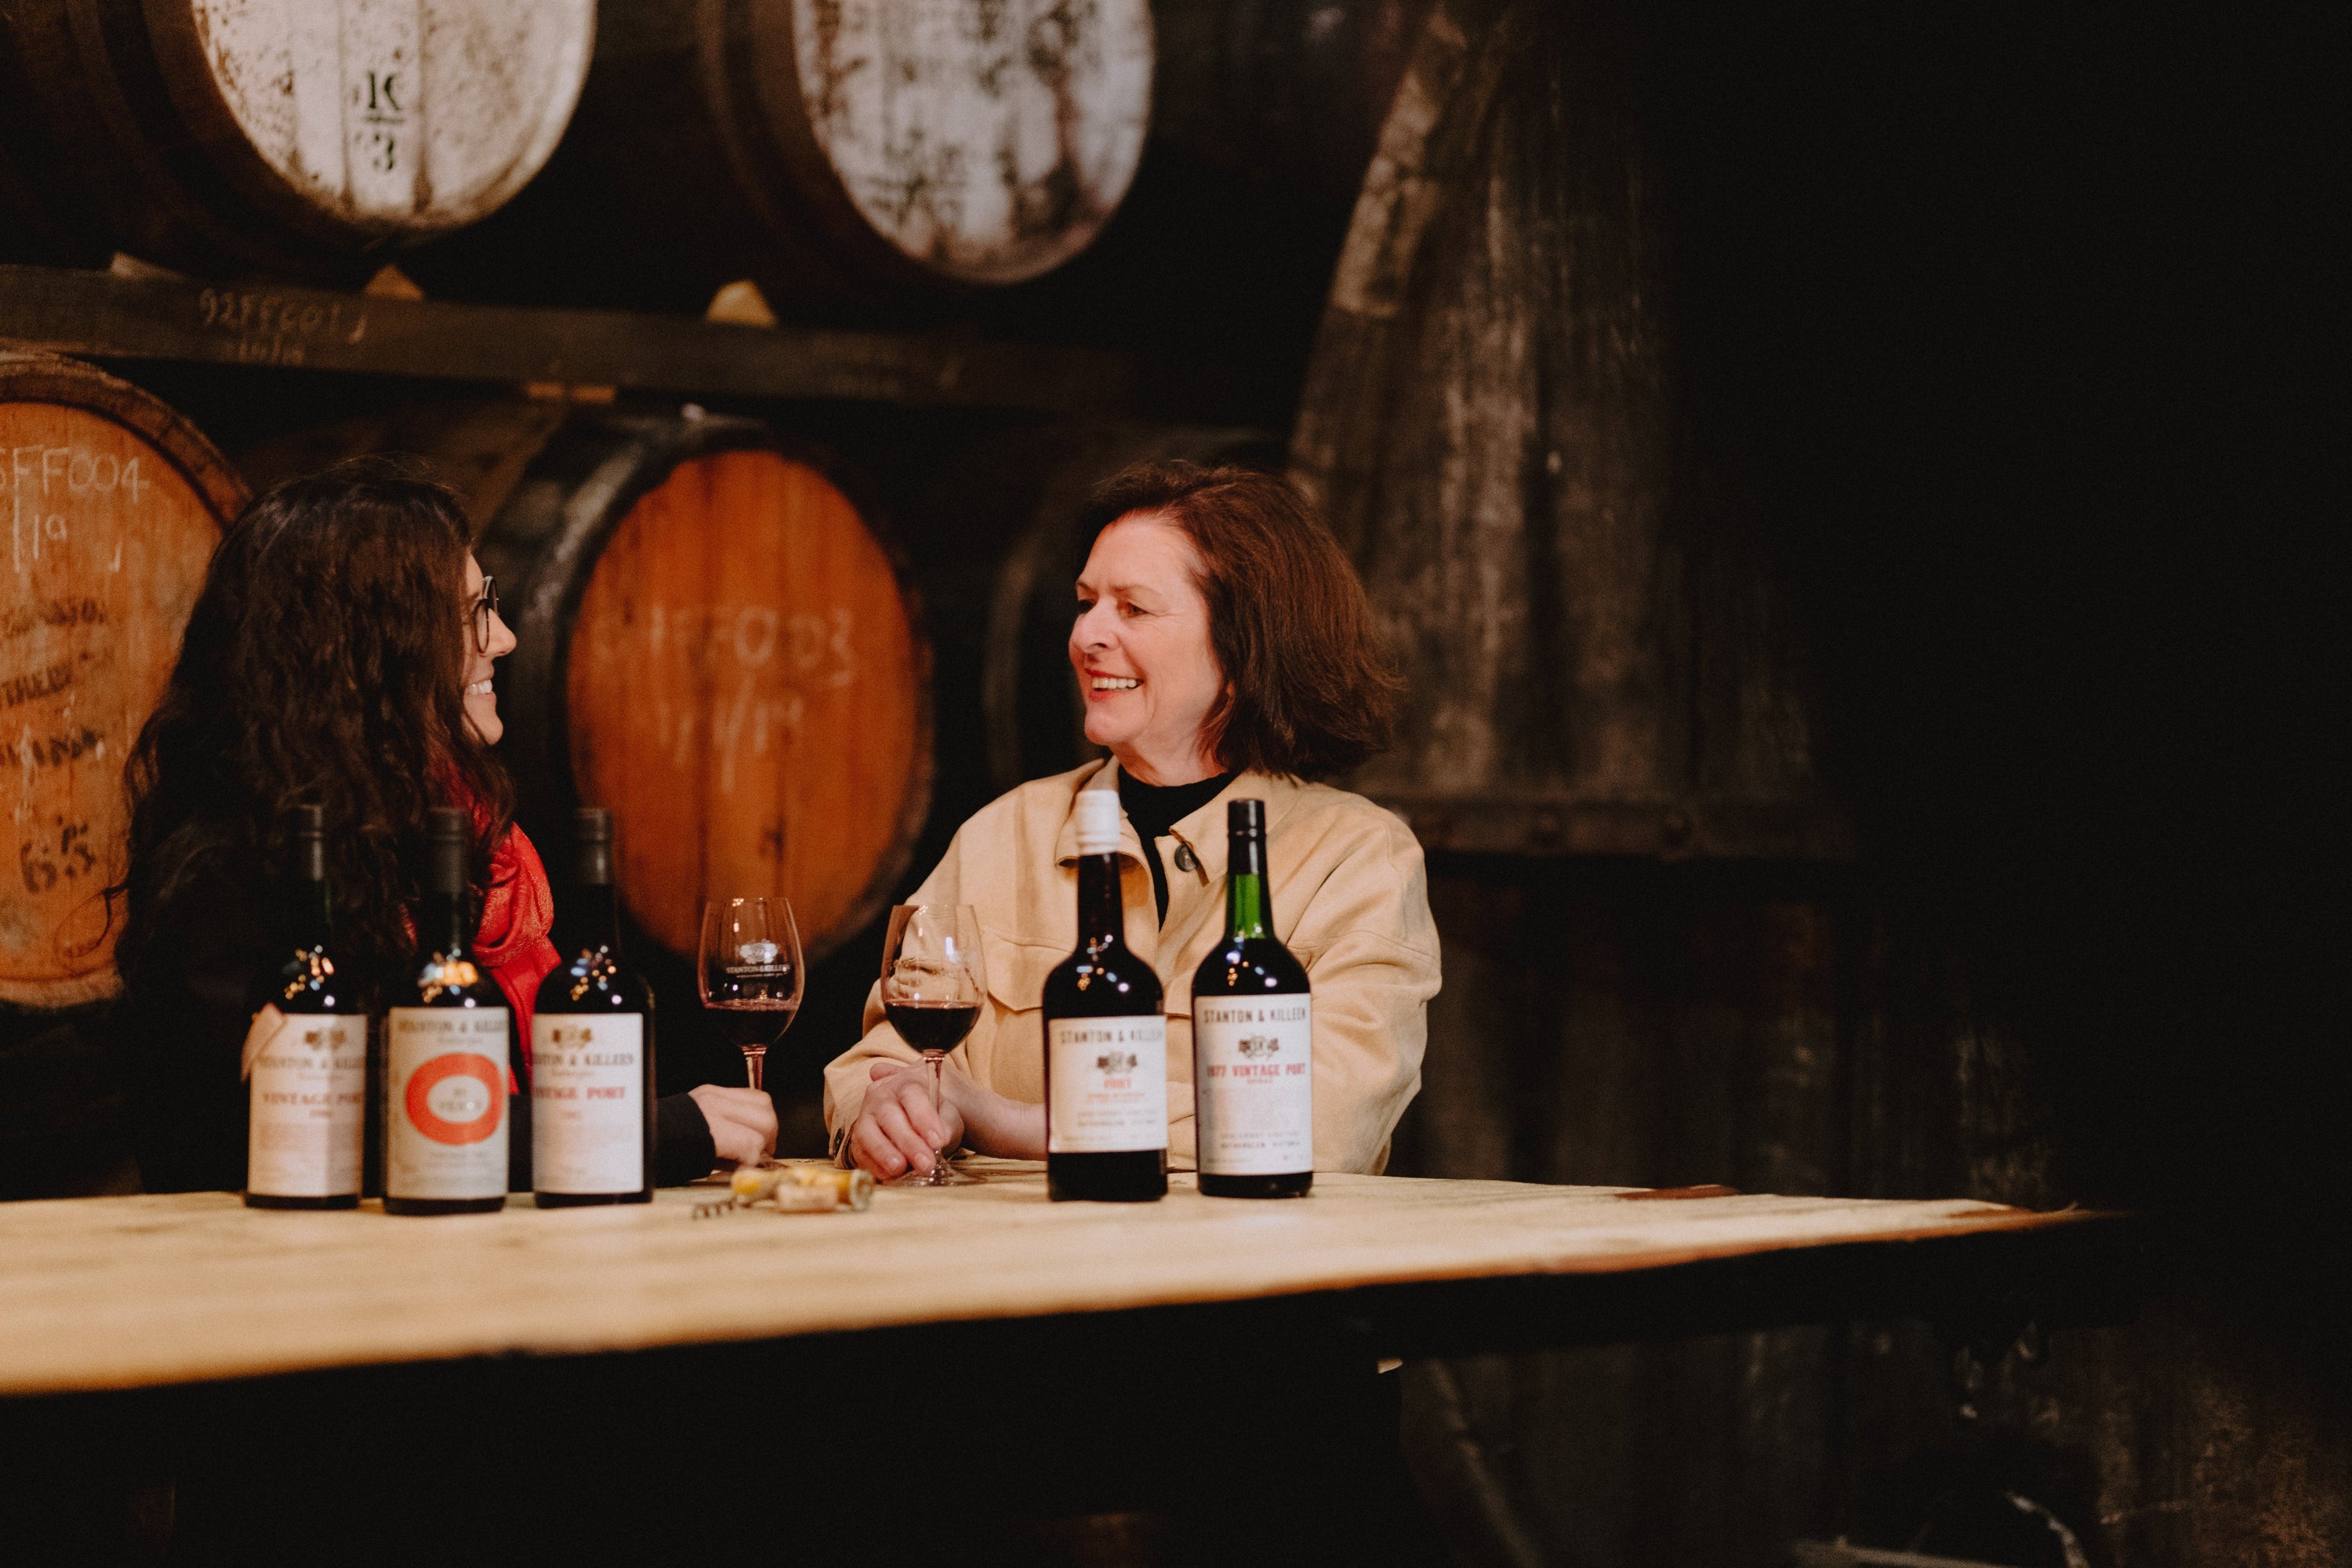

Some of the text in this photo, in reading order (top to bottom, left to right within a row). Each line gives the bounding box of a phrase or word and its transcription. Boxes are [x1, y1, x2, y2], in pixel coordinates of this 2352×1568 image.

[1204, 1008, 1253, 1024] STANTON
[1258, 1008, 1265, 1022] &
[1232, 1064, 1281, 1077] VINTAGE
